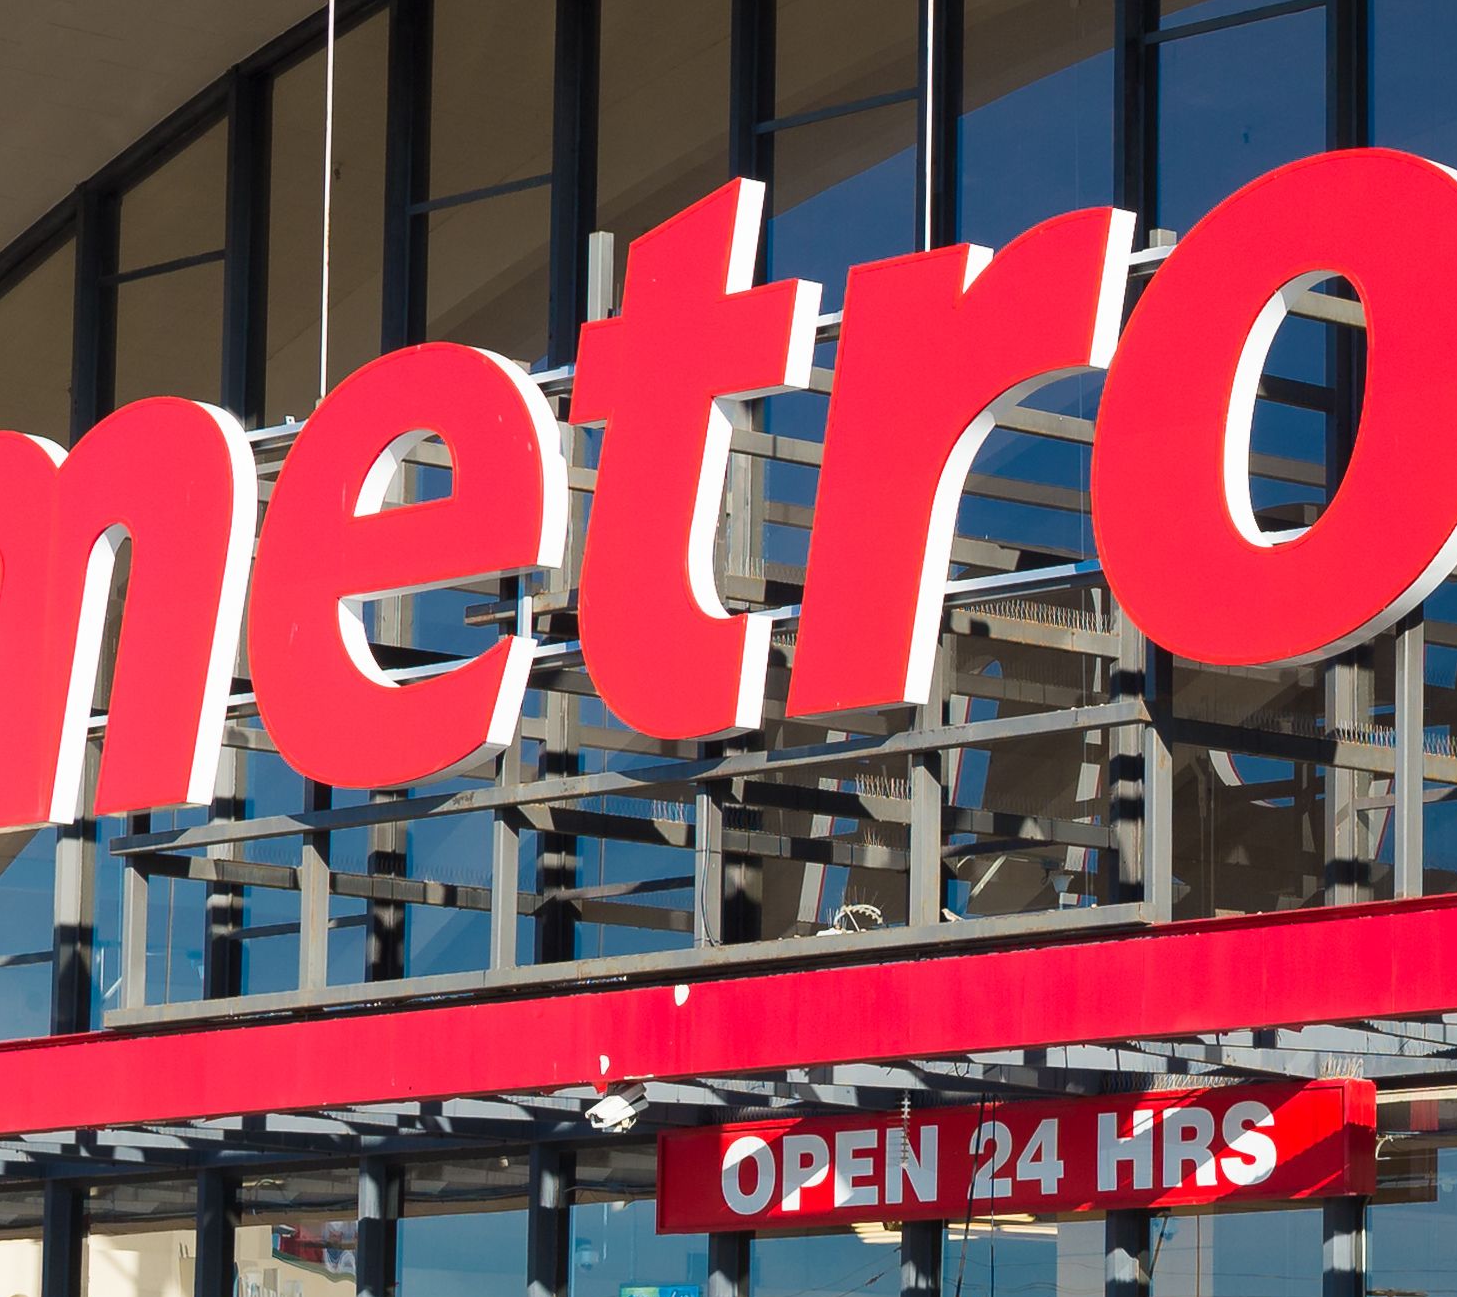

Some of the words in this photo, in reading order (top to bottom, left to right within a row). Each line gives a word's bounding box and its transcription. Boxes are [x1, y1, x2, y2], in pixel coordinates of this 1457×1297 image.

[721, 1123, 939, 1216] OPEN
[968, 1117, 1065, 1200] 24
[1097, 1100, 1279, 1192] HRS
